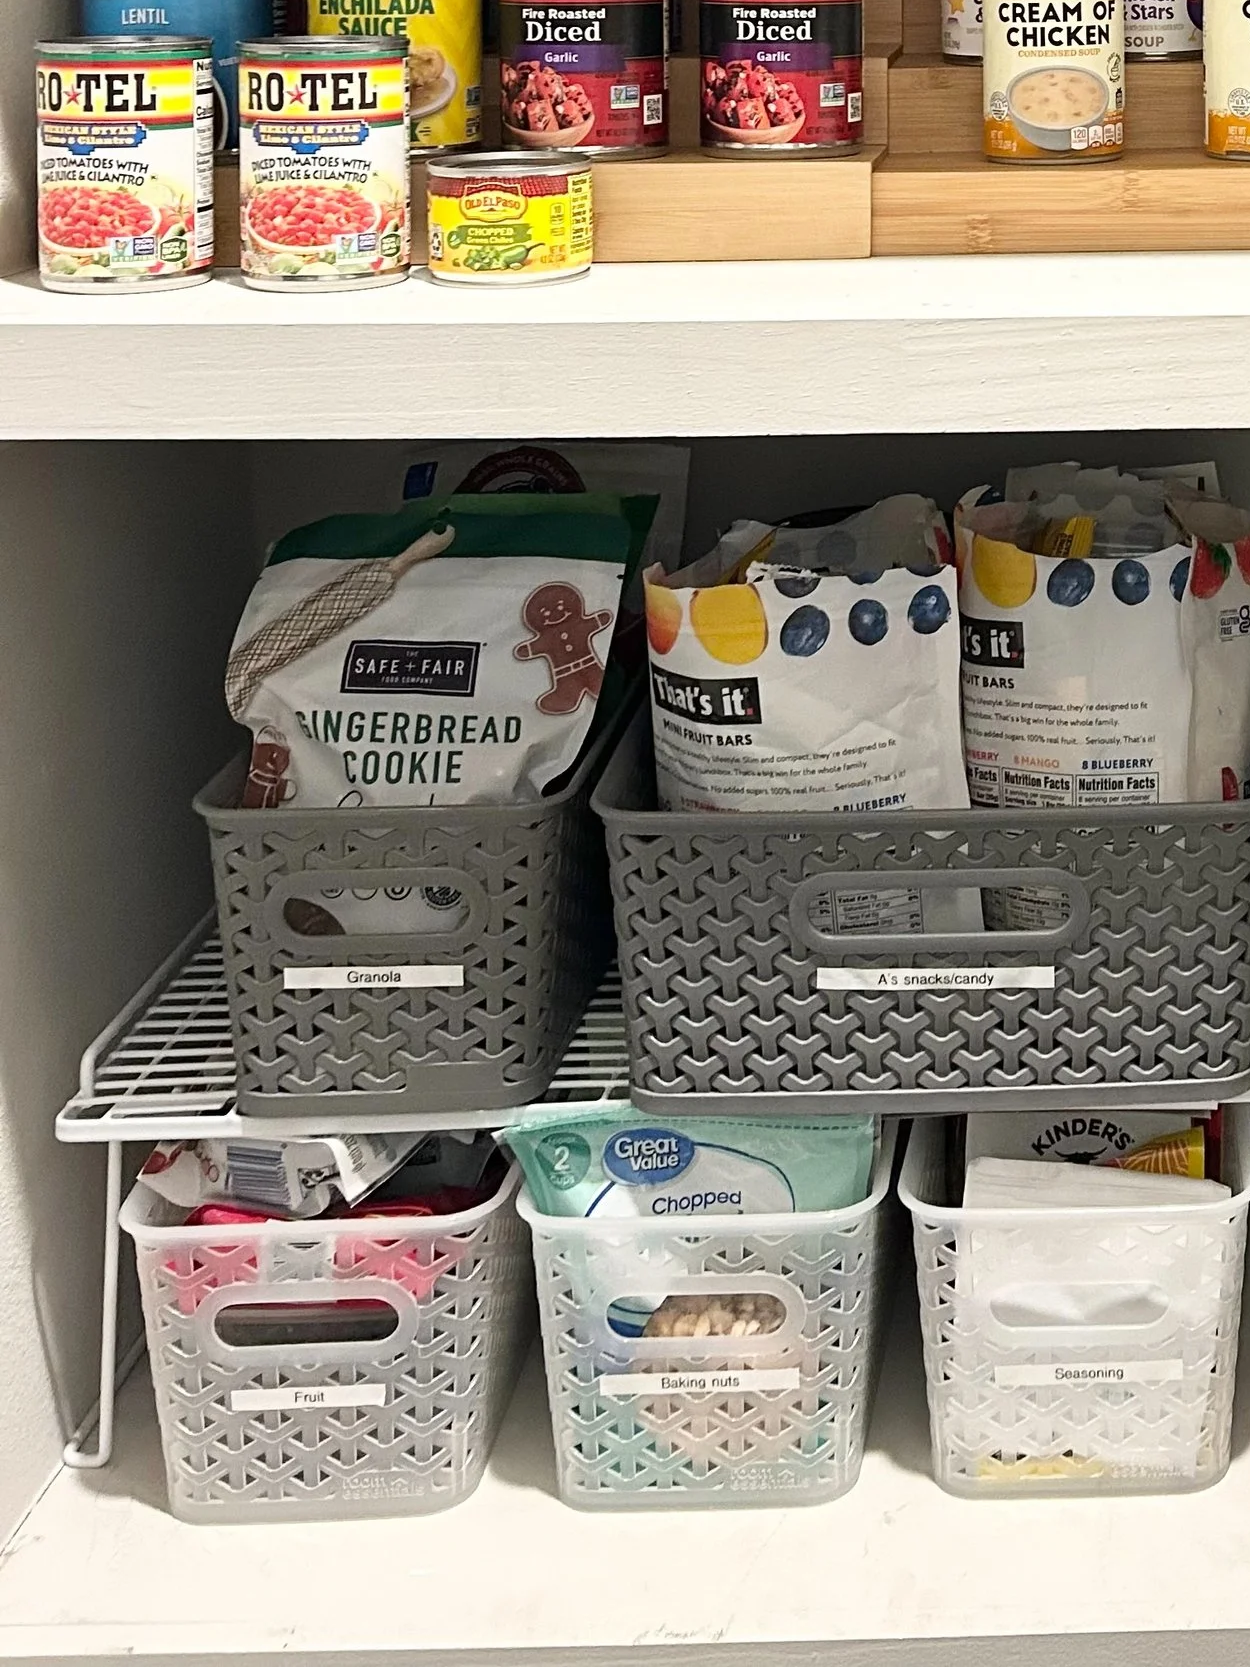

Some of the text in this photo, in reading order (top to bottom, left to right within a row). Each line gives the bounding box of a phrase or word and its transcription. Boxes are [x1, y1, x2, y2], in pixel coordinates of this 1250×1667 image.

[121, 8, 170, 25] LENTIL
[522, 7, 606, 20] Fire Roasted
[998, 0, 1117, 23] CREAM OF
[525, 21, 602, 42] Diced
[1006, 24, 1111, 47] CHICKEN
[544, 52, 579, 64] Garlic
[277, 157, 340, 169] TOMATOES
[313, 169, 367, 183] CILANTRO
[467, 227, 514, 236] CHOPPED
[354, 658, 466, 676] SAFE FAIR
[653, 673, 713, 716] That's
[1095, 701, 1129, 712] designed
[295, 710, 522, 744] GINGERBREAD
[683, 727, 753, 747] FRUIT BARS
[343, 750, 463, 784] COOKIE
[1091, 758, 1153, 770] BLUEBERRY
[1078, 777, 1155, 791] Nutrition Facts
[347, 971, 401, 984] Granola
[878, 973, 995, 987] A's snacks/candy
[1032, 1118, 1134, 1156] KINDER'S
[614, 1137, 679, 1158] Great
[630, 1152, 680, 1171] Value
[652, 1191, 742, 1215] Chopped
[1054, 1367, 1124, 1381] Seasoning
[661, 1376, 740, 1391] Baking nuts
[294, 1392, 325, 1403] Fruit
